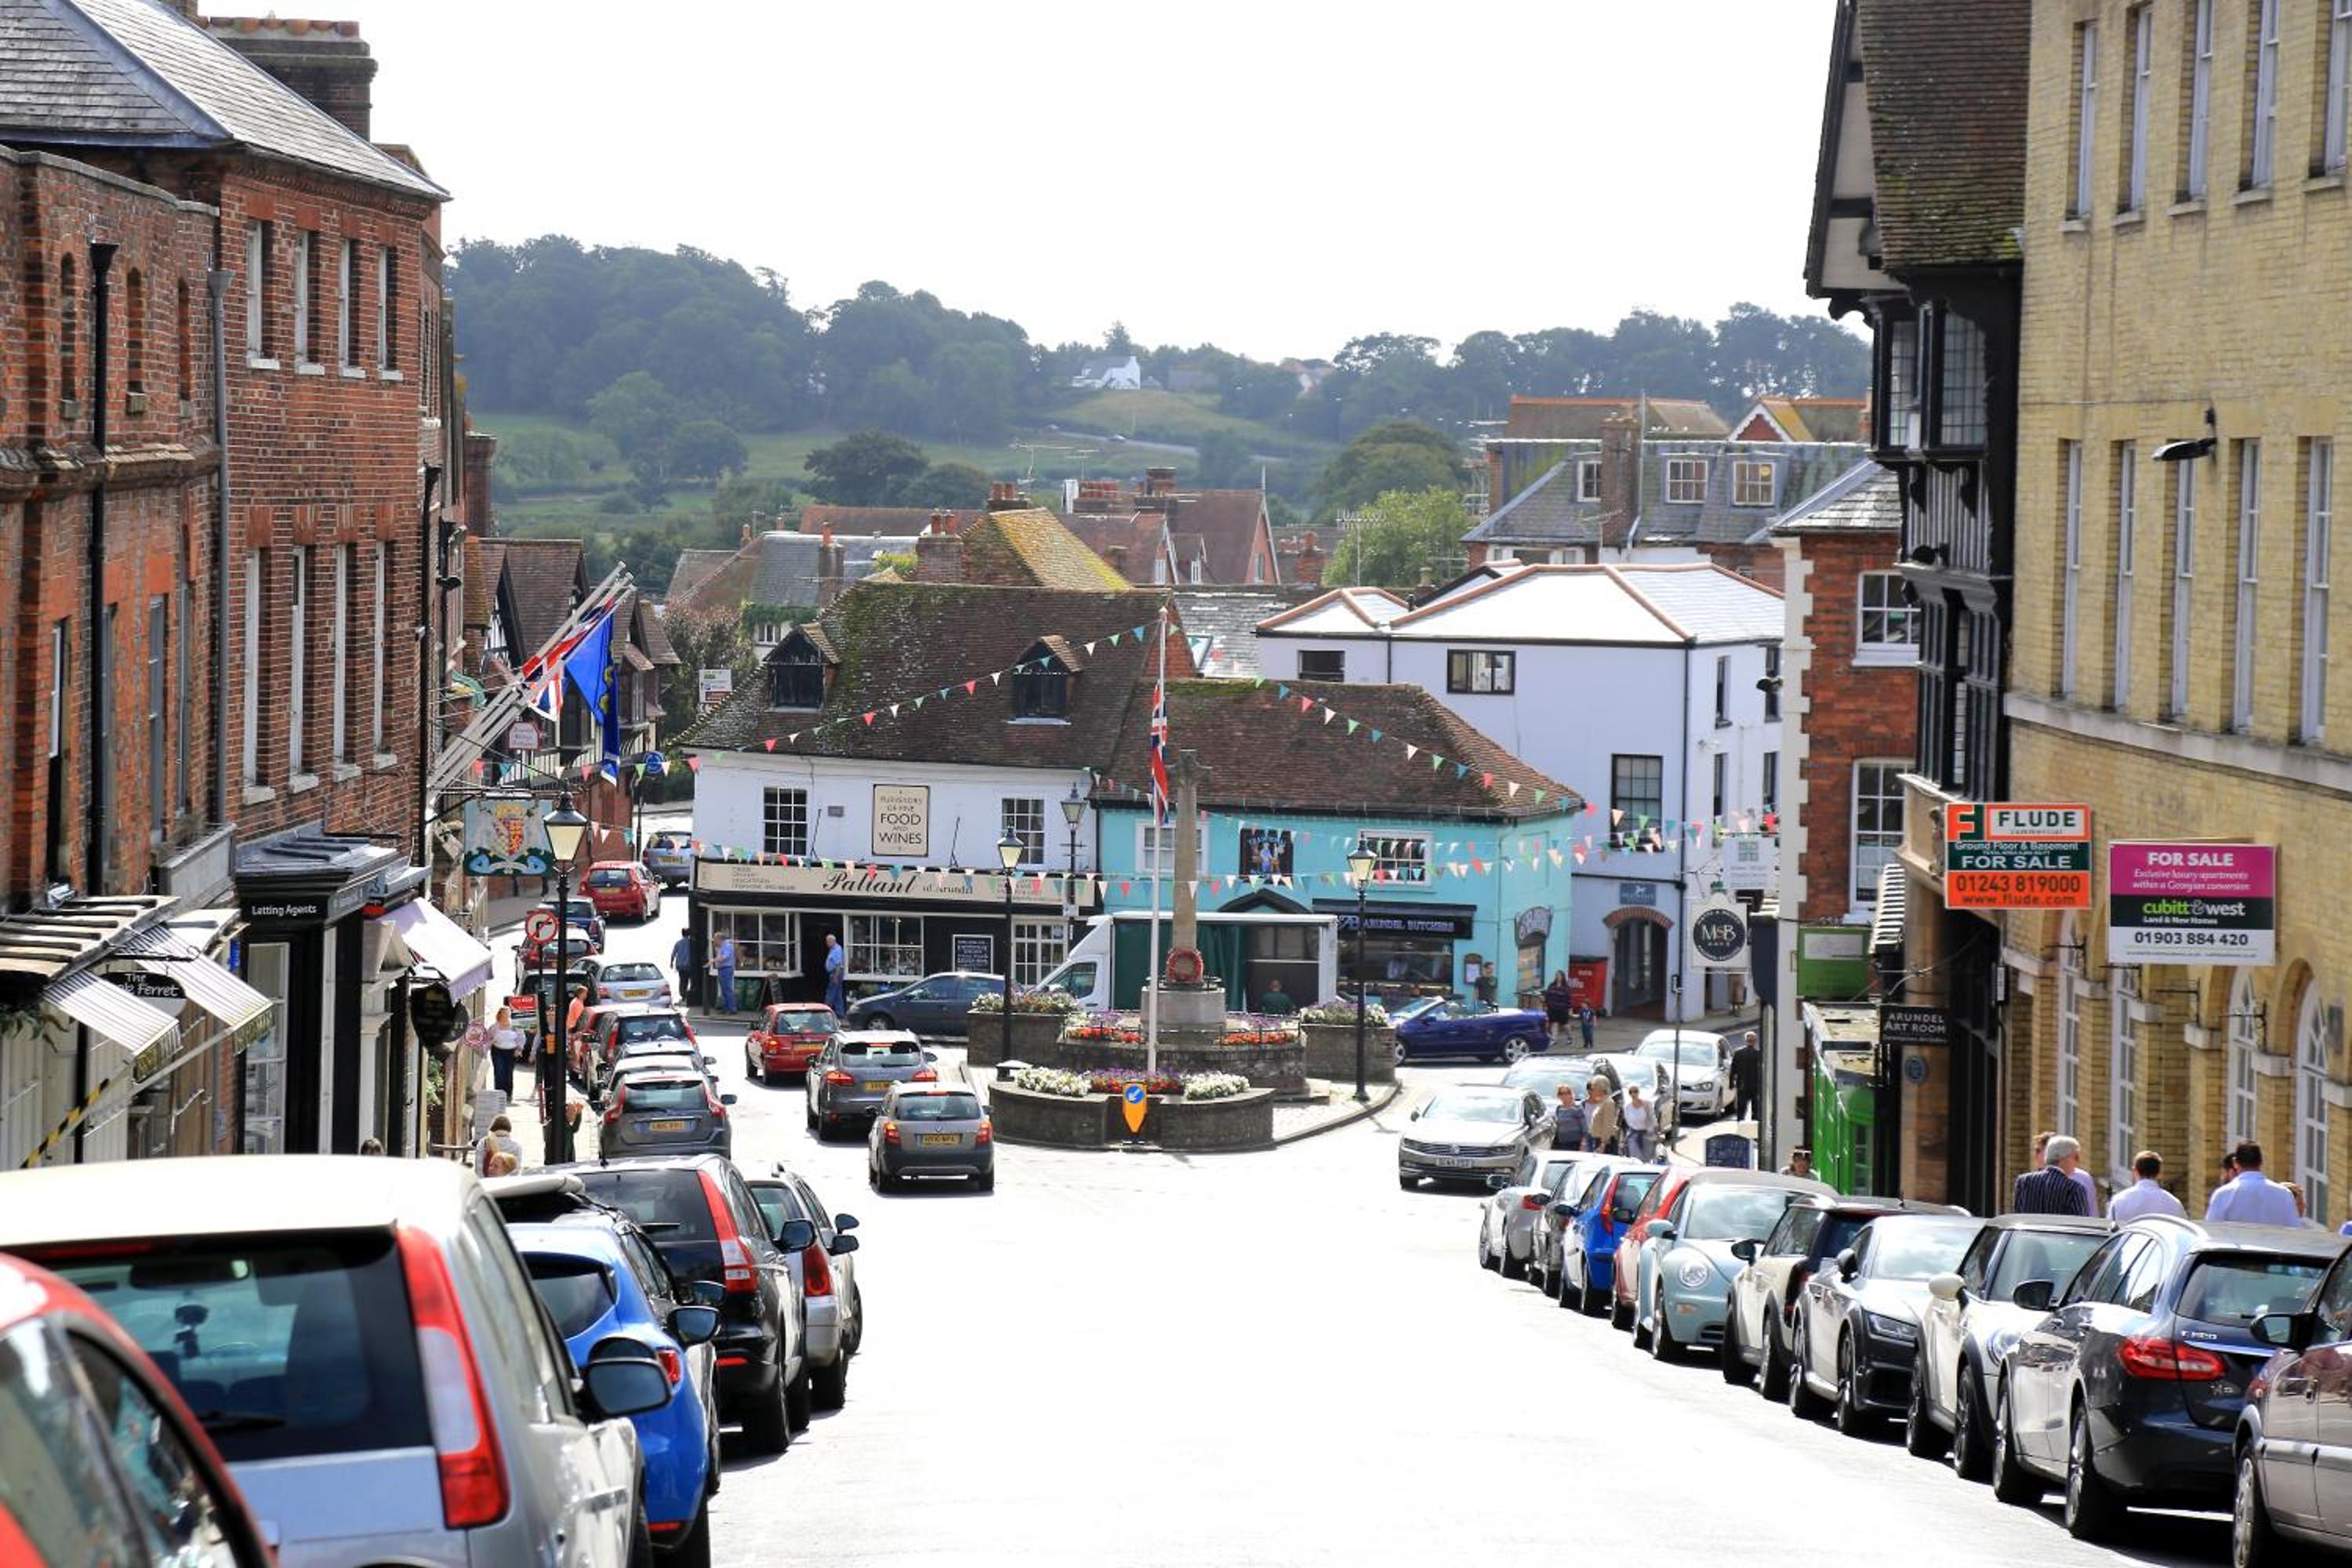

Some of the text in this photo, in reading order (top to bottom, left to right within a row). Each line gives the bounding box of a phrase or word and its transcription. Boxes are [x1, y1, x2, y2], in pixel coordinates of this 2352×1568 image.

[880, 813, 921, 825] FOOD
[1998, 811, 2076, 827] FLUDE
[879, 833, 923, 844] WINES
[1955, 842, 1990, 851] Ground
[1962, 855, 2072, 869] FOR SALE
[2147, 852, 2234, 866] FOR SALE
[2135, 869, 2249, 881] Exclusive luxury apartments
[1957, 875, 2080, 892] 01243 819000
[2133, 880, 2158, 889] within
[2167, 881, 2205, 893] Georgian
[252, 905, 317, 916] Letting Agents
[1363, 919, 1405, 930] ARUNDEL
[1407, 920, 1455, 932] BUTCHERS
[2135, 932, 2249, 946] 01903 884 420
[125, 973, 147, 982] The
[137, 984, 180, 996] Ferret
[1889, 1013, 1944, 1023] ARUNDEL
[1884, 1021, 1945, 1034] ART ROOM
